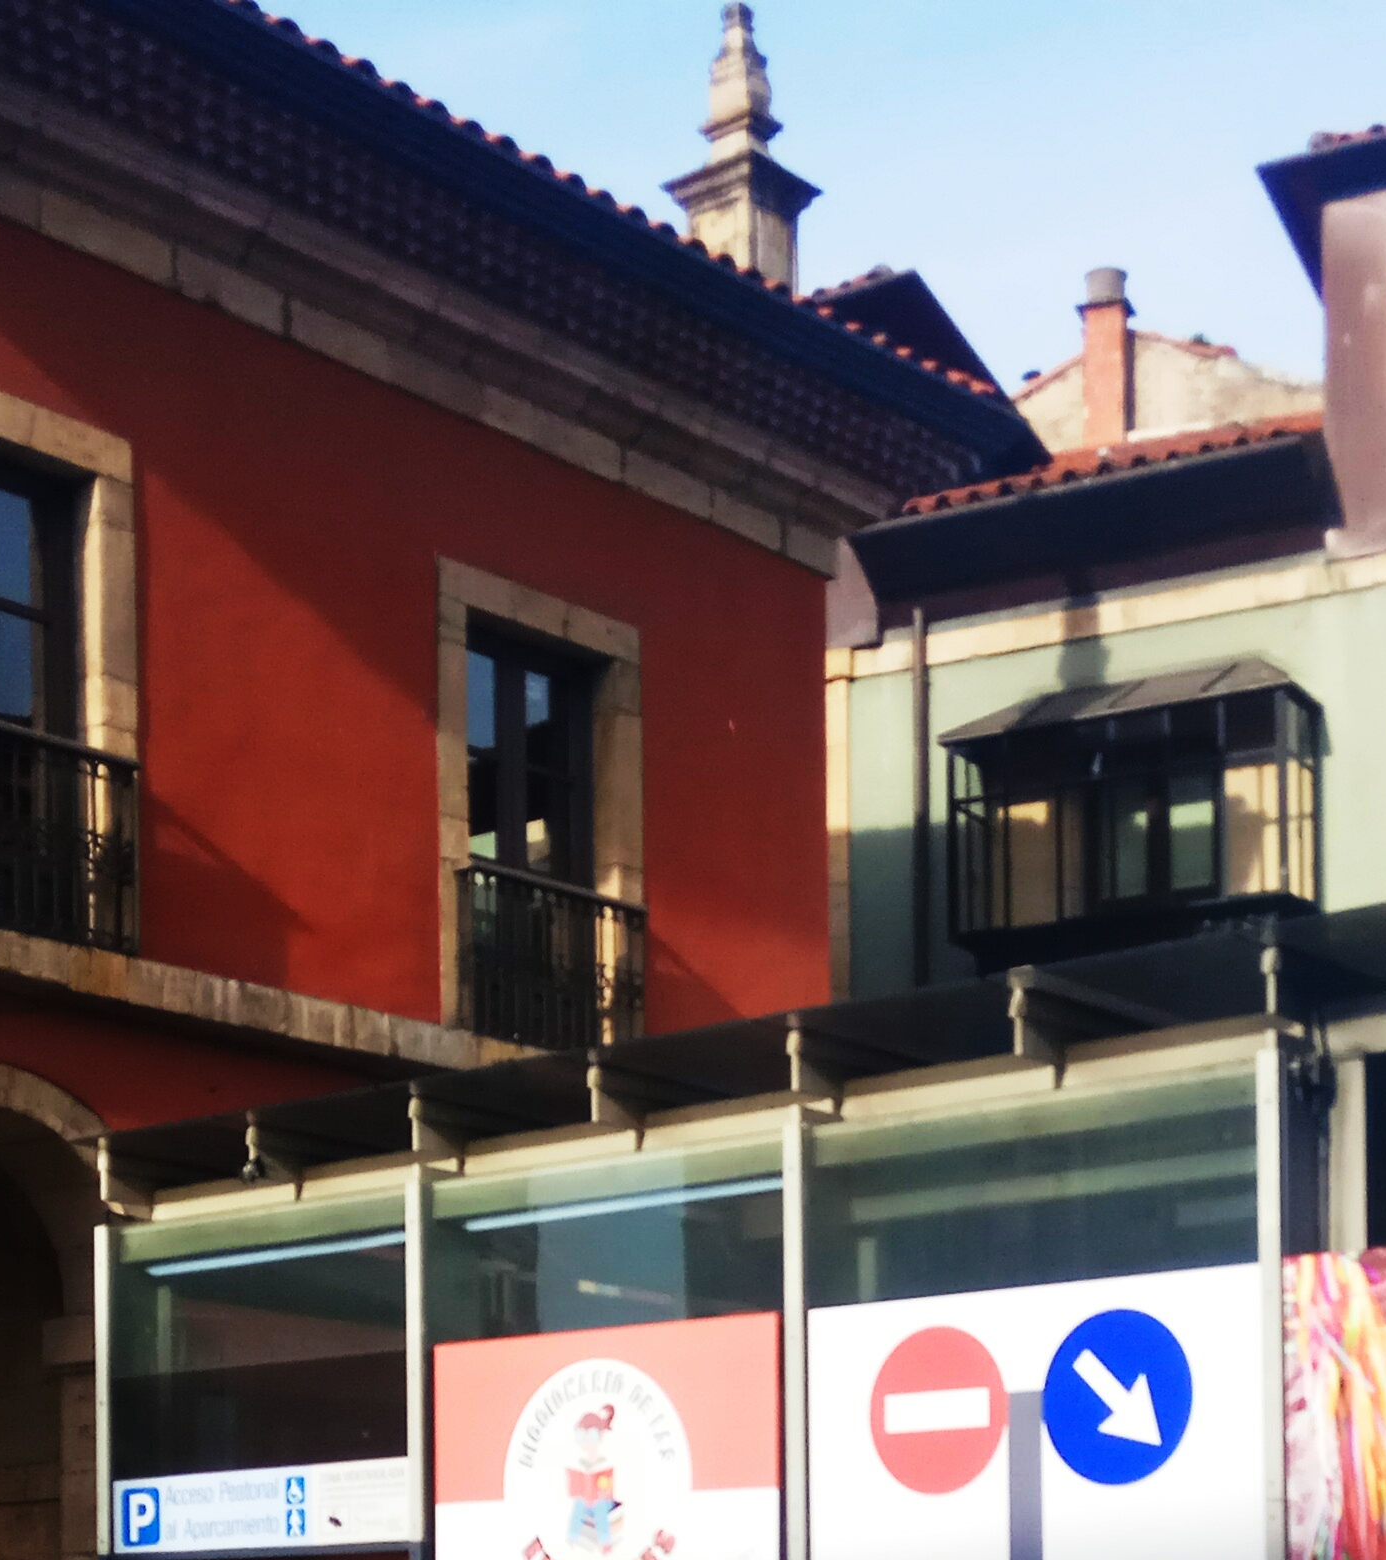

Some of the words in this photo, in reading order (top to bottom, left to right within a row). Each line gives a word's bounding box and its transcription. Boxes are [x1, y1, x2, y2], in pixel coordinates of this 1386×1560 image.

[164, 1483, 214, 1506] Acceso
[218, 1478, 279, 1502] Peatonal
[129, 1494, 156, 1542] P
[164, 1520, 177, 1540] al
[183, 1514, 279, 1541] Aparcamiento
